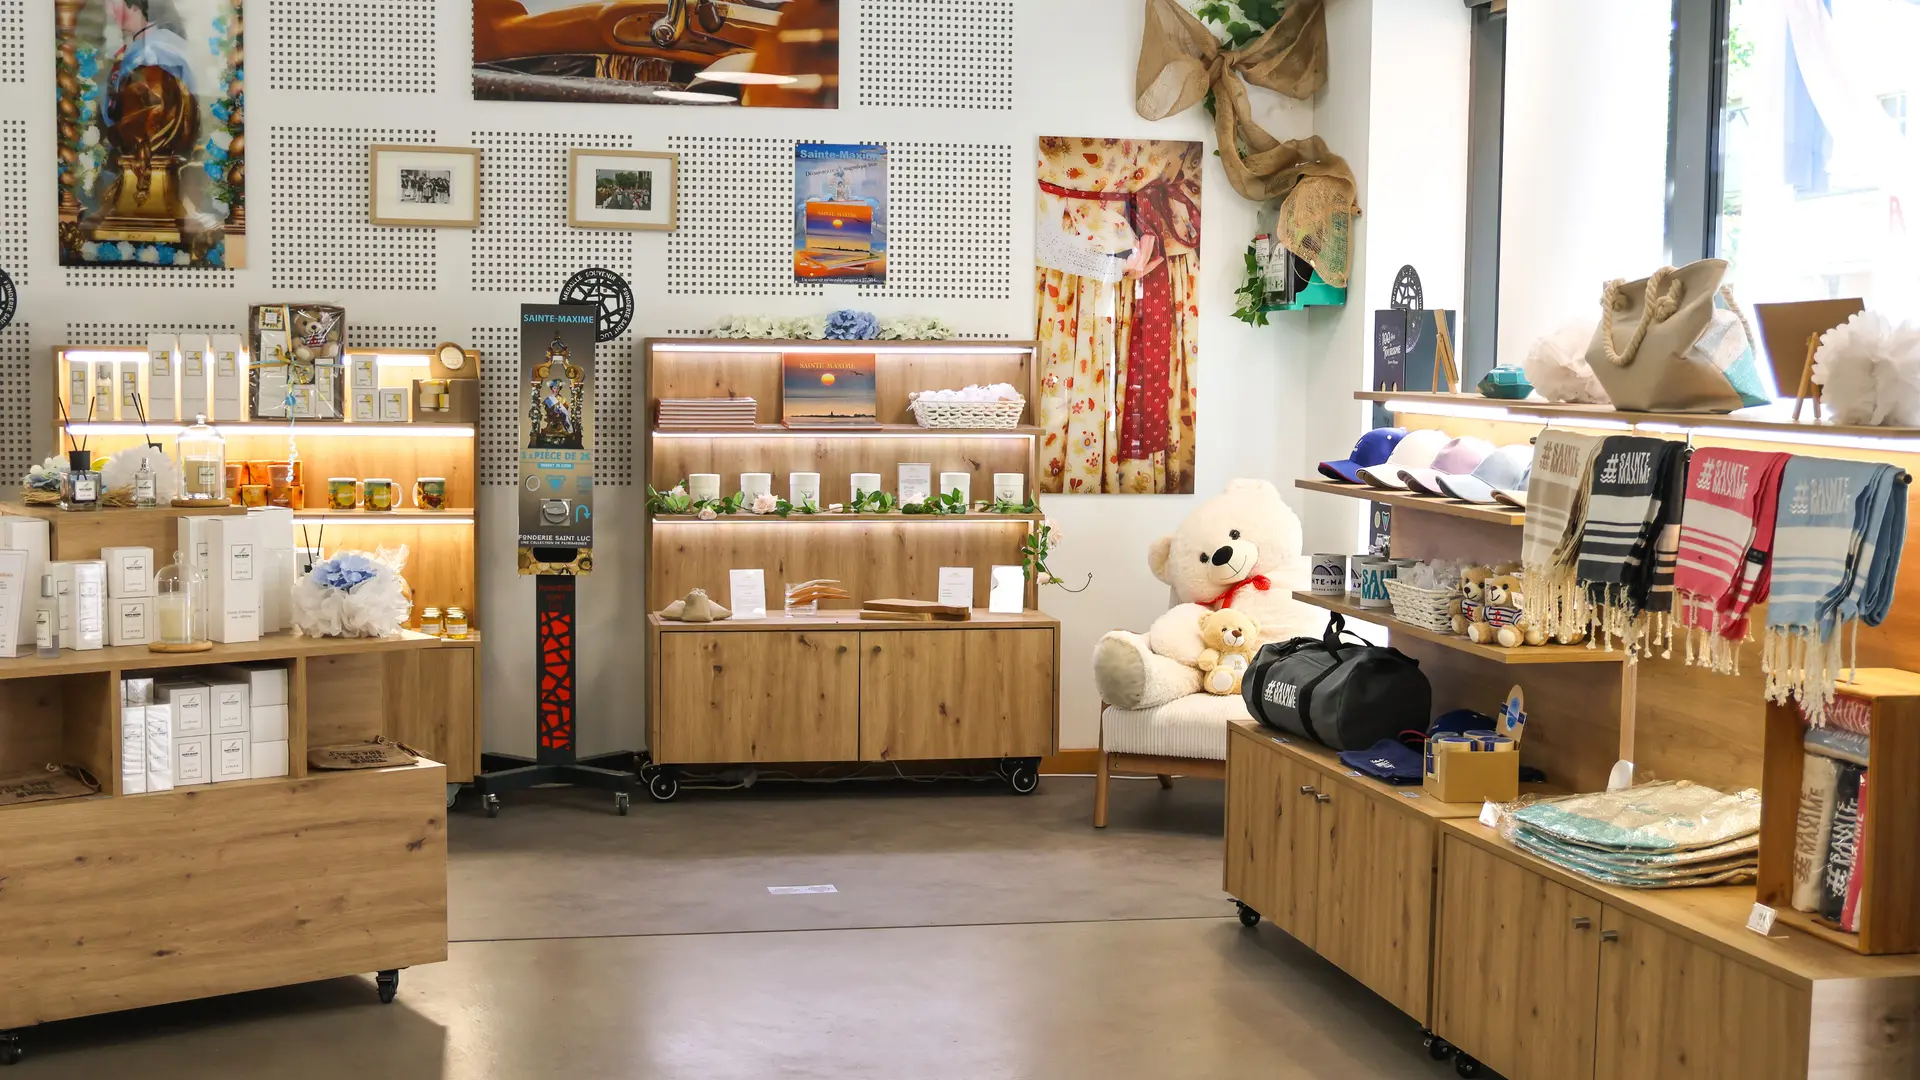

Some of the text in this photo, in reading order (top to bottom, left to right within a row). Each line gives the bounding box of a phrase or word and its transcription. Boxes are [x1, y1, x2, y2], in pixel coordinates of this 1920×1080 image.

[585, 270, 617, 282] SOUVENIR
[523, 314, 594, 324] SAINTE-MAXIME
[600, 287, 632, 340] FONDERIE SAINT LUC
[534, 448, 561, 460] PIÈCE
[564, 452, 576, 460] DE
